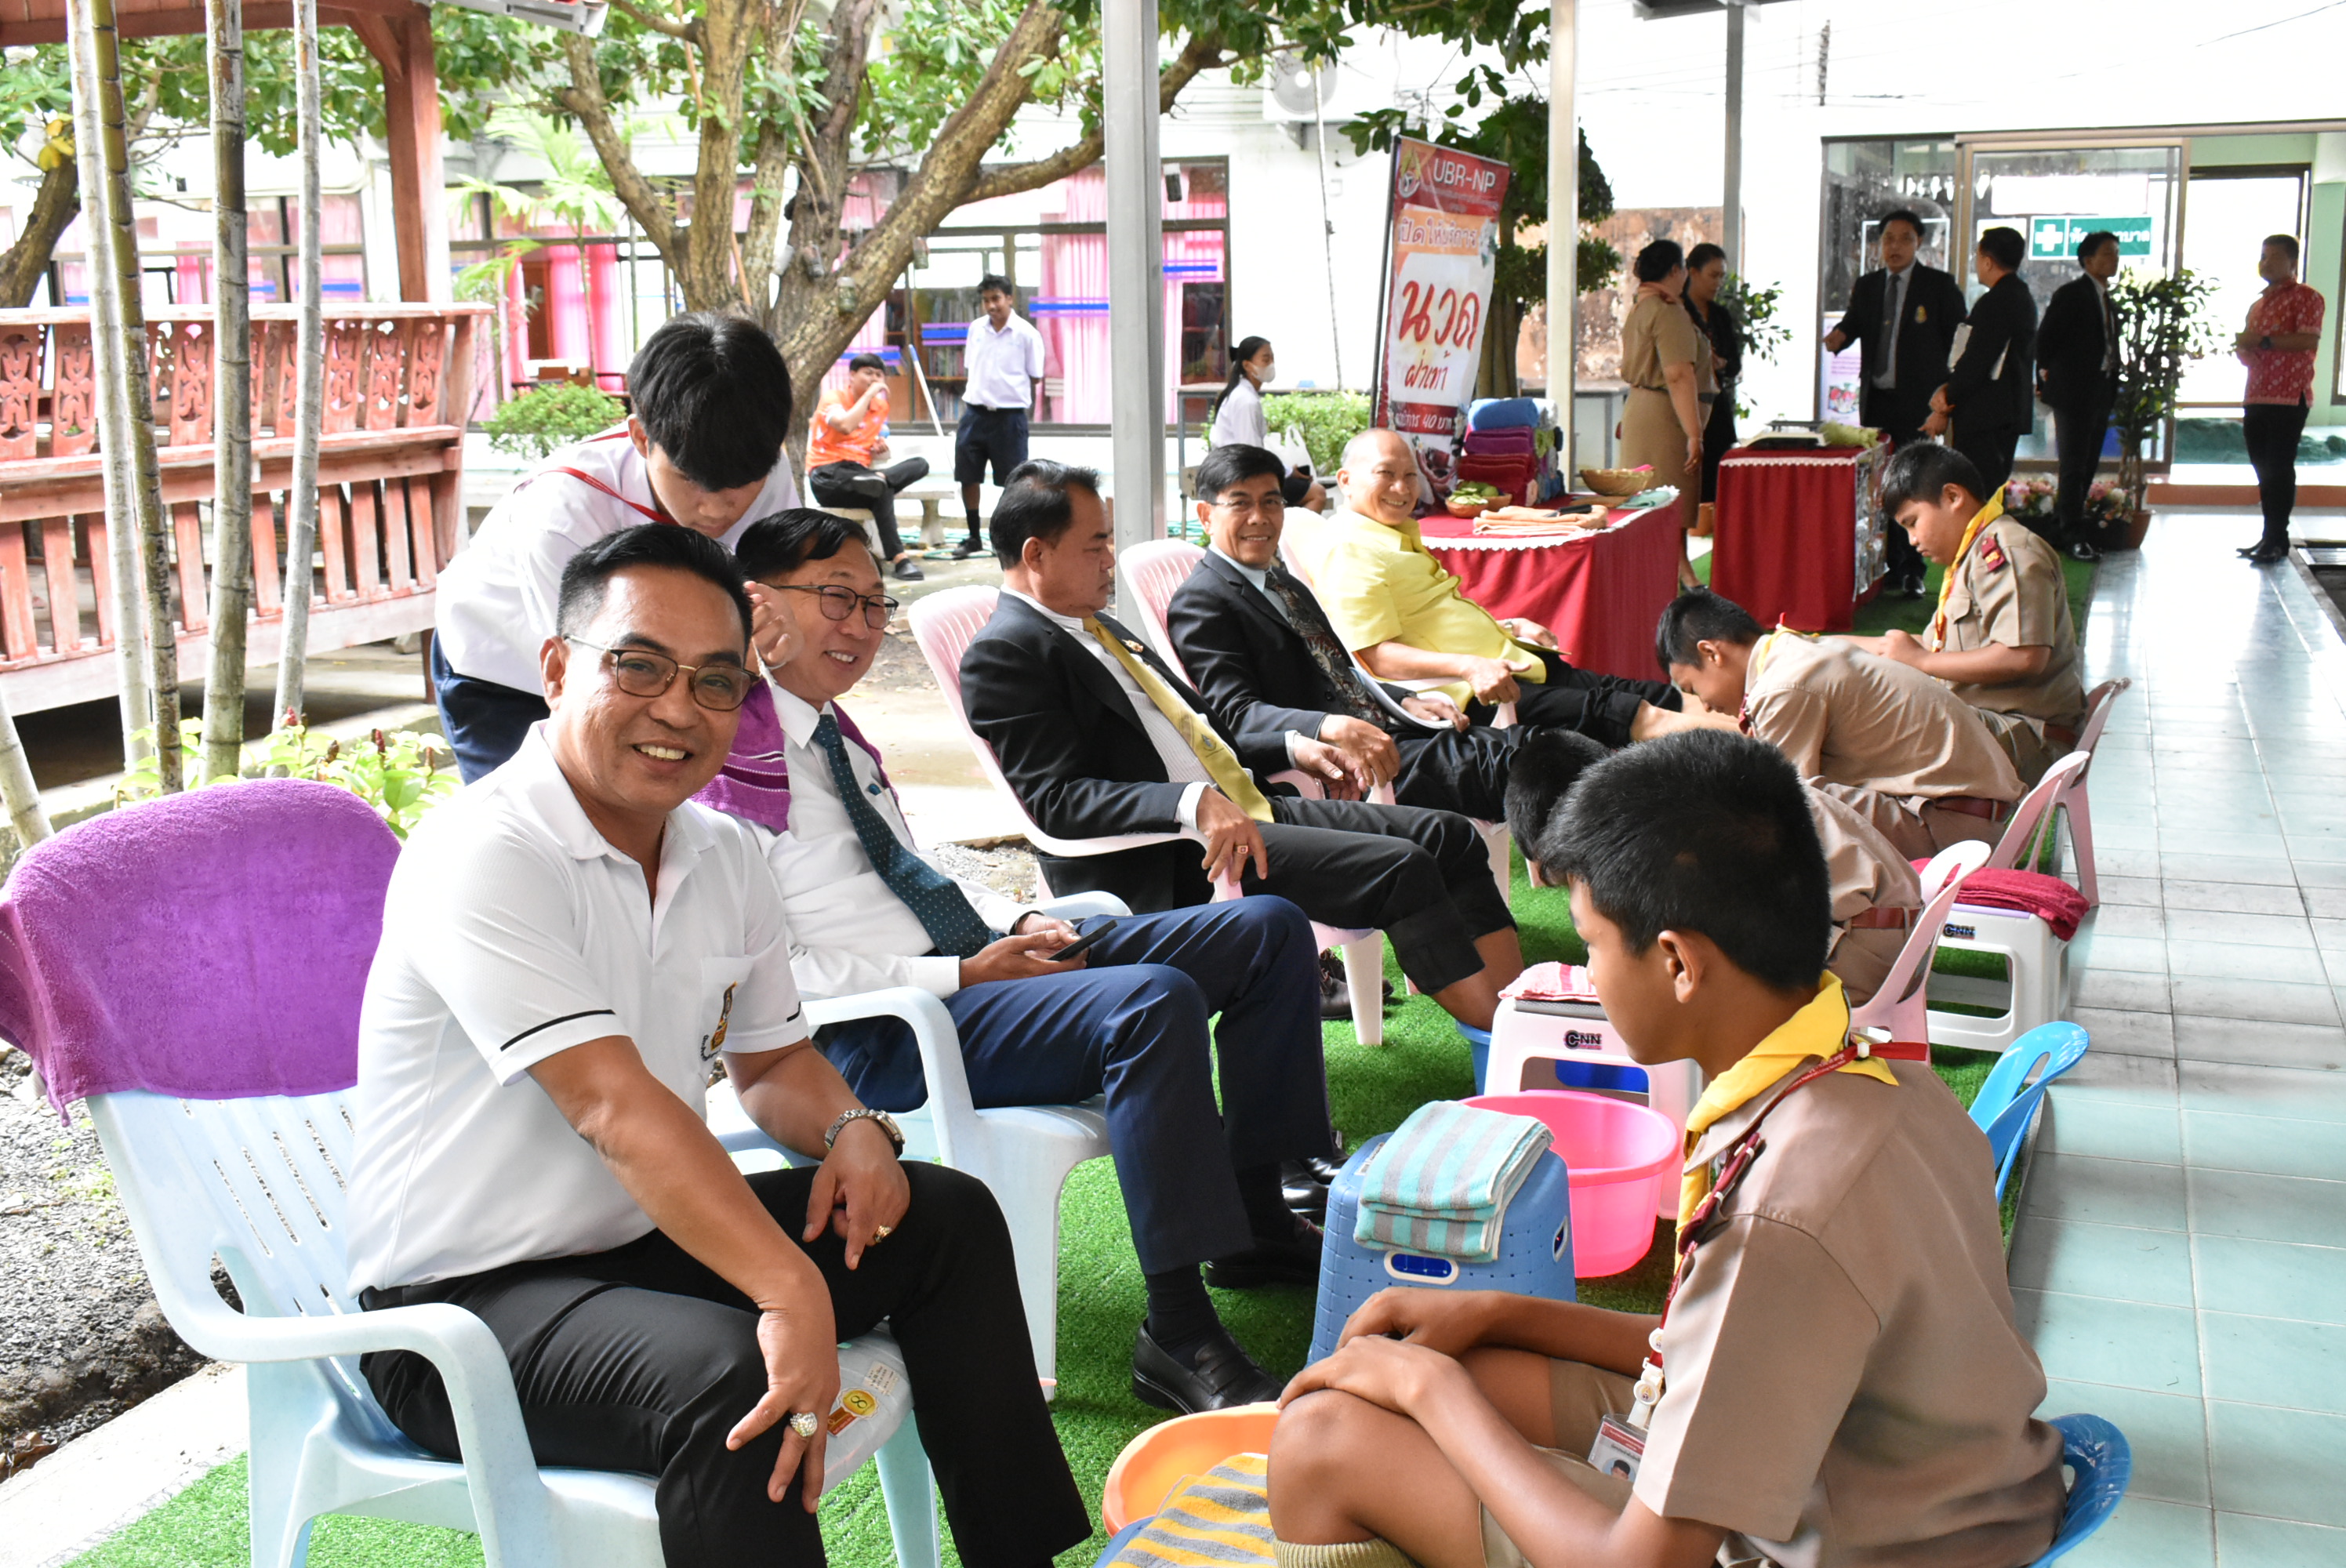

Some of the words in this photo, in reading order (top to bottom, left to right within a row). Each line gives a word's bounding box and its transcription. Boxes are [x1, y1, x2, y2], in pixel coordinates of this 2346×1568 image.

[1433, 158, 1496, 193] UBR-NP
[1399, 280, 1480, 350] นวด
[1404, 349, 1451, 390] ฝ่าเท้า
[1423, 414, 1437, 430] 40
[1943, 924, 1975, 938] CNN
[1563, 1029, 1602, 1049] CNN
